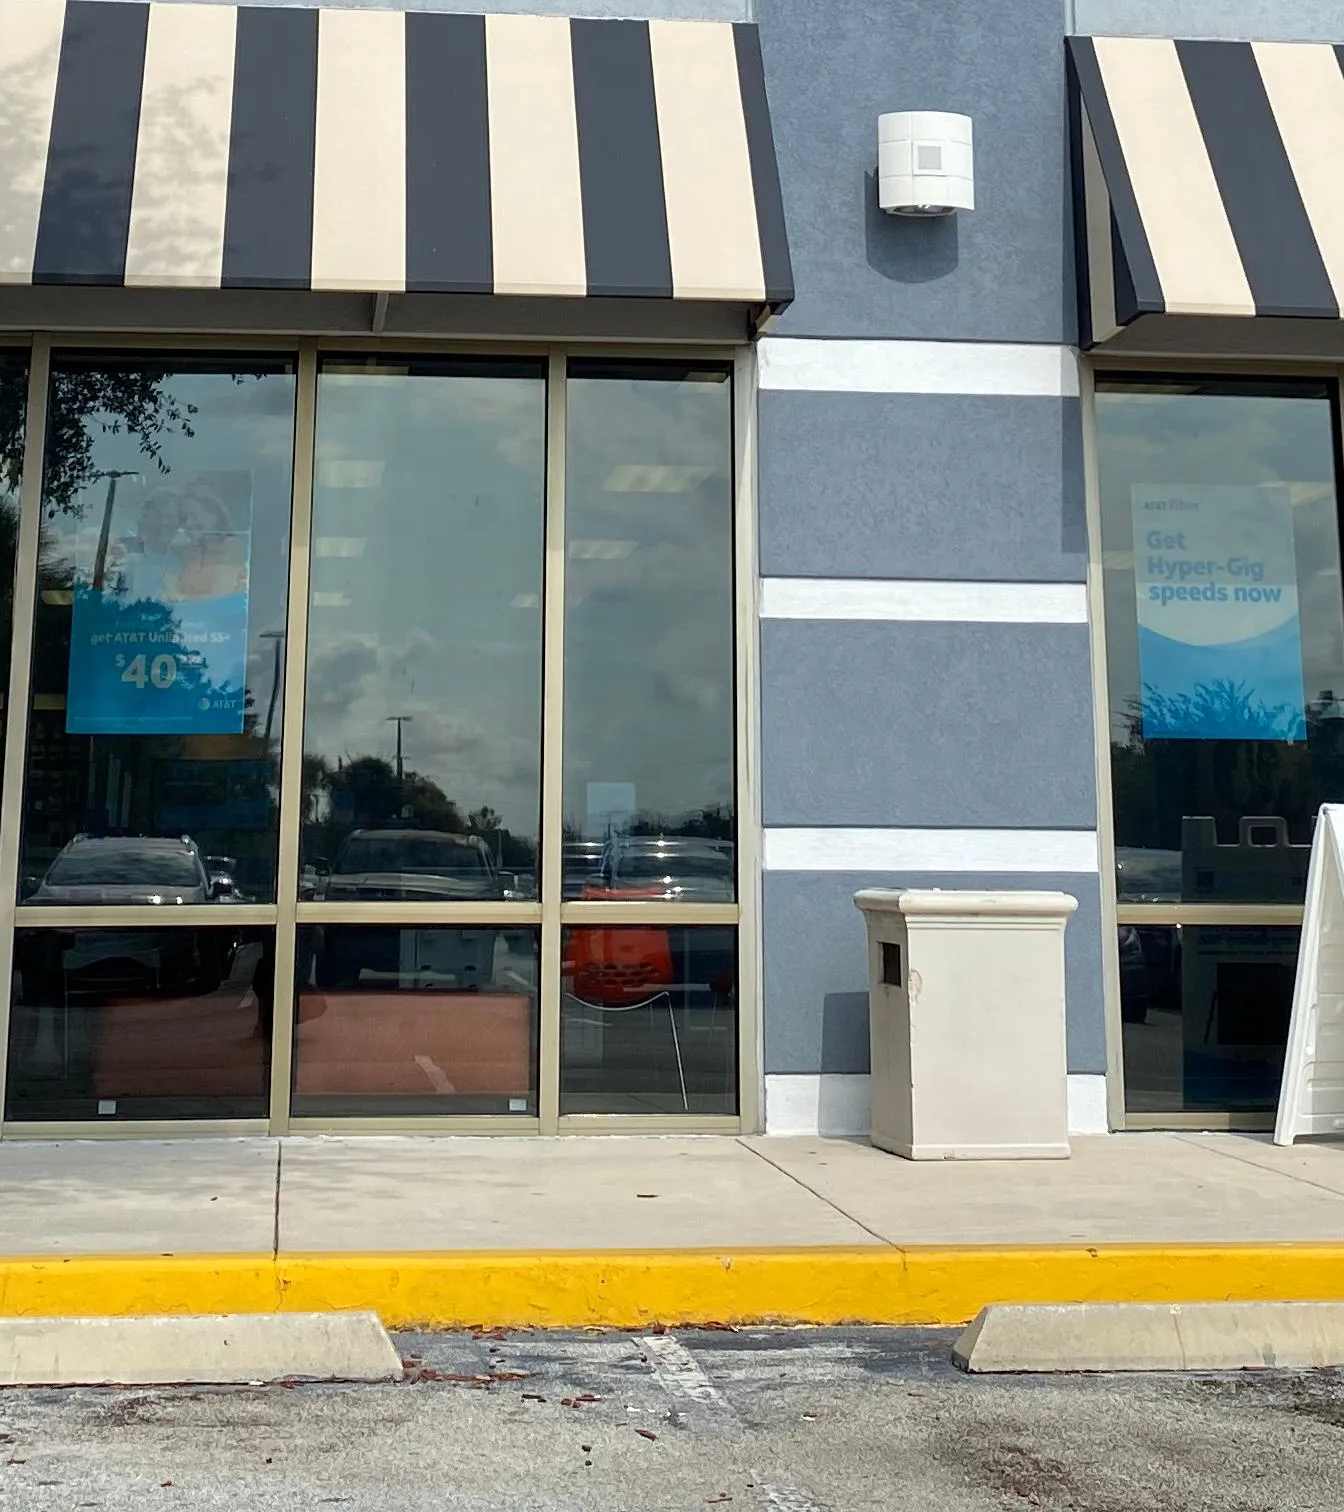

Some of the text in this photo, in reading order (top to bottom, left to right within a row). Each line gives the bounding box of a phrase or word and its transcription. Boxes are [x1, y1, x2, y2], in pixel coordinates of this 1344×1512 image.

[1146, 530, 1187, 550] Get
[1147, 556, 1264, 582] Hyper-Gig
[1148, 581, 1282, 607] speeds now
[114, 633, 146, 643] AT&T
[115, 653, 178, 689] $40
[211, 699, 238, 710] AT&T
